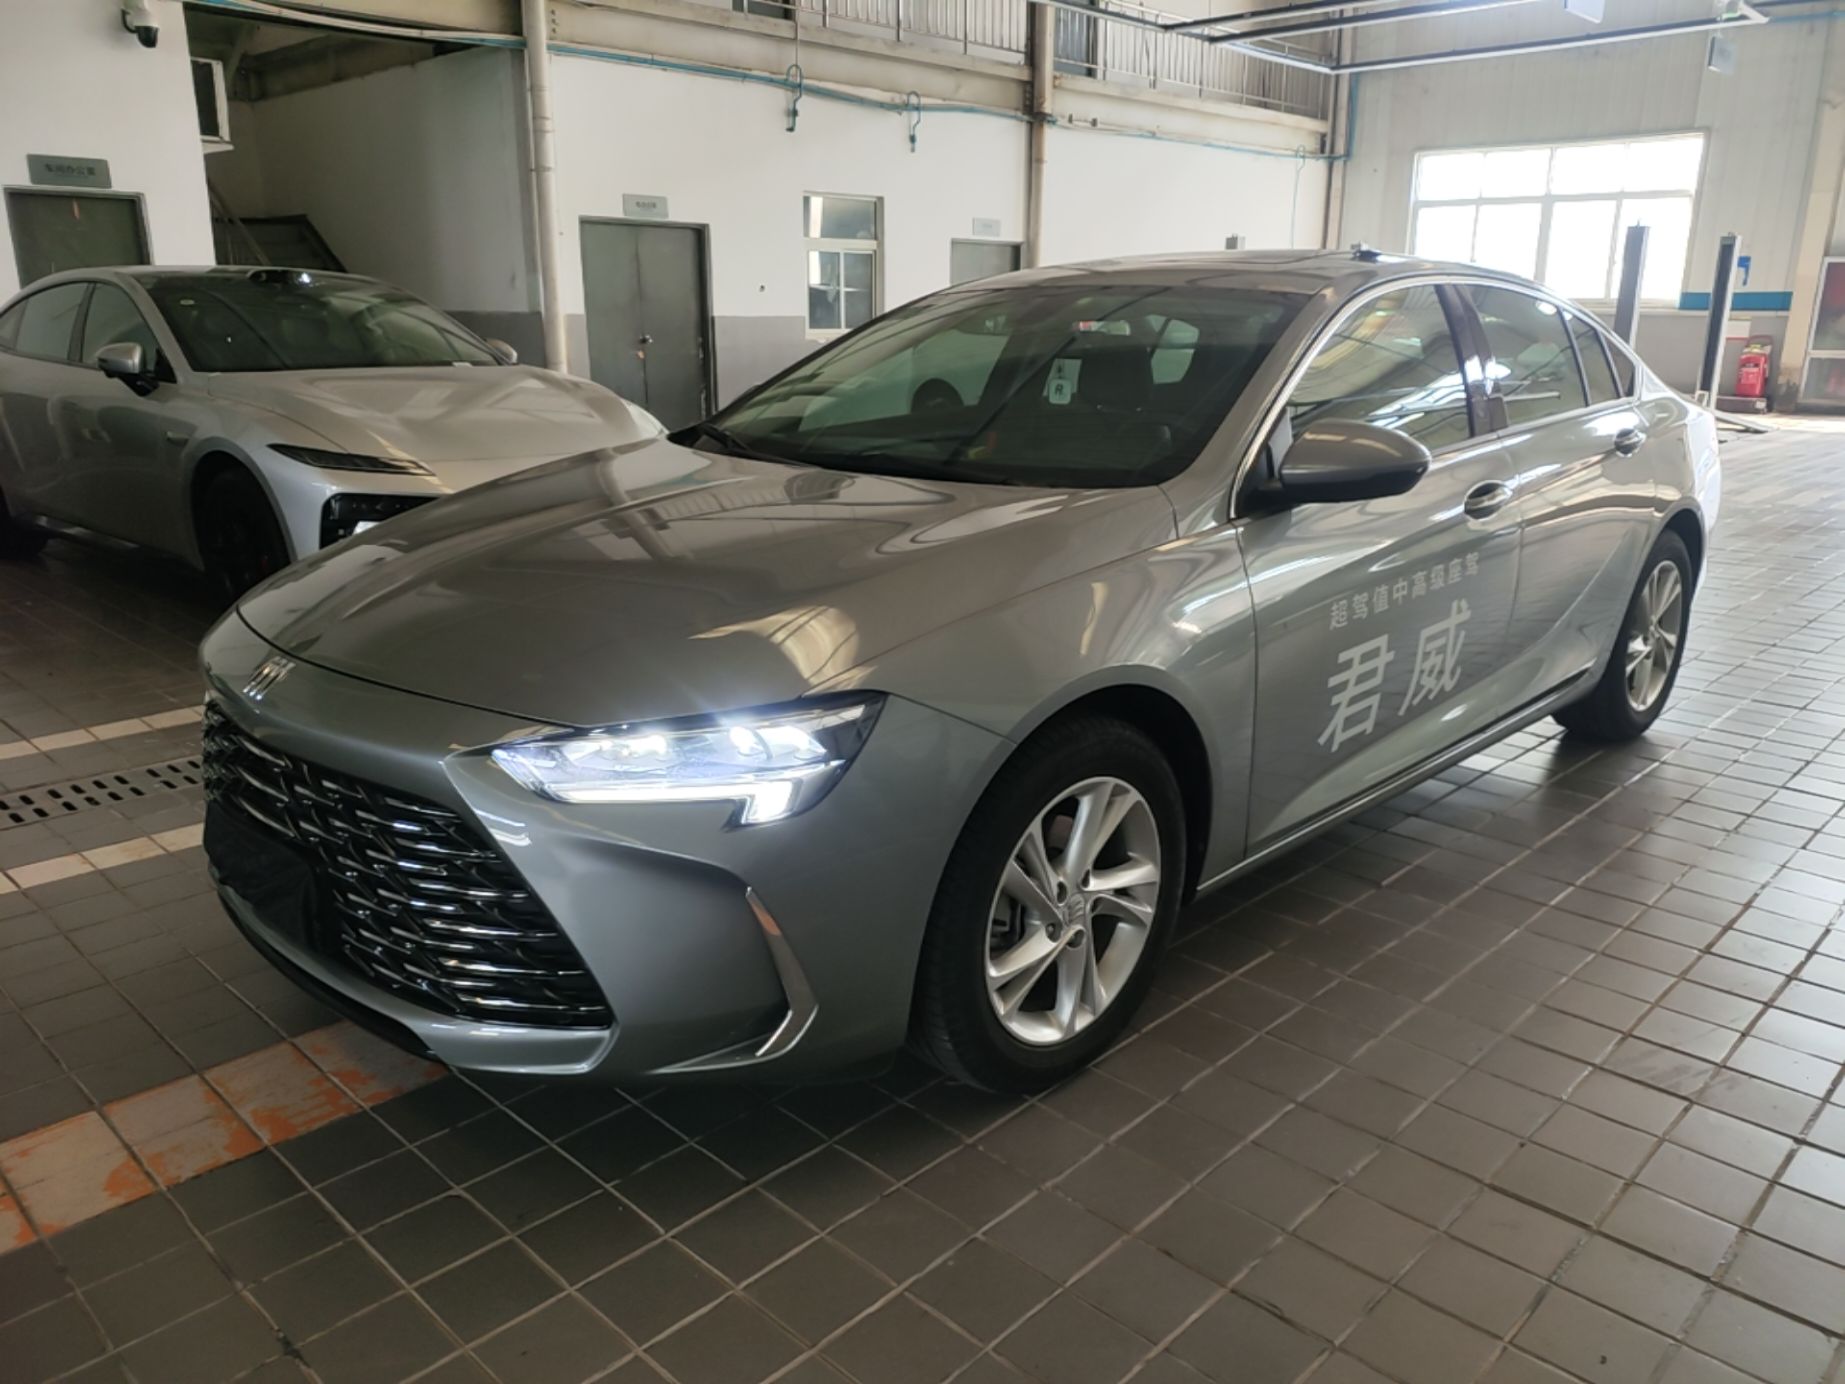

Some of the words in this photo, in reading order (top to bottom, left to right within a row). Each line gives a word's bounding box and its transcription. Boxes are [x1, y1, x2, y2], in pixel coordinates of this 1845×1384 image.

[1329, 552, 1480, 630] 超驾值中高级座驾
[1317, 599, 1471, 752] 君威
